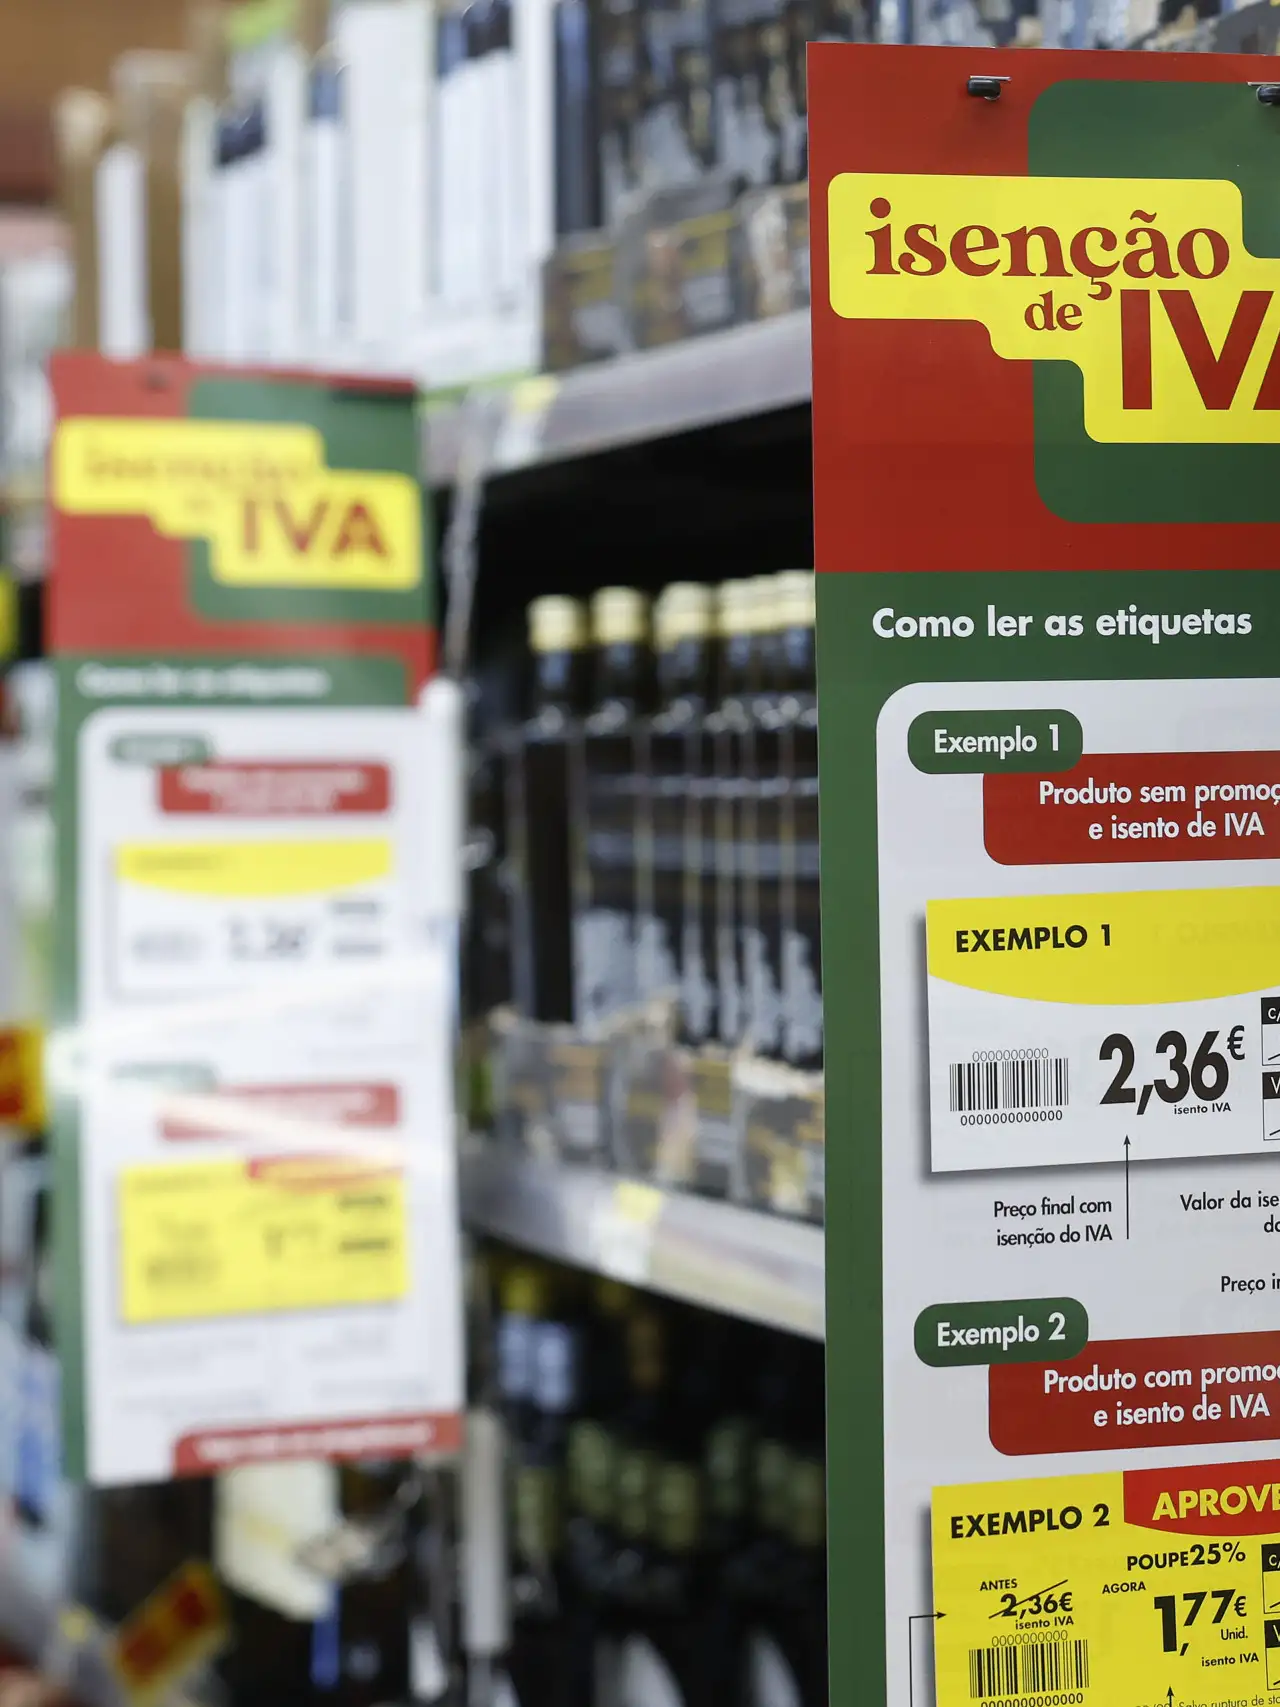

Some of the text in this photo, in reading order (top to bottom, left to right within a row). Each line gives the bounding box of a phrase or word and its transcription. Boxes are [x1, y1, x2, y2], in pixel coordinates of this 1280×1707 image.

[865, 197, 1230, 300] isenção
[1023, 289, 1083, 331] de
[872, 604, 1253, 644] Como ler as etiquetas
[934, 724, 1059, 759] Exemplo 1
[1039, 777, 1131, 804] Produto
[1140, 782, 1186, 802] sem
[1088, 811, 1265, 839] e isento de IVA
[955, 924, 1111, 953] EXEMPLO 1
[972, 1047, 1049, 1062] 0000000000
[1099, 1025, 1246, 1115] 2,36€
[960, 1109, 1063, 1126] 0000000000000
[1174, 1102, 1231, 1115] isento IVA
[993, 1197, 1112, 1220] Preço final com
[1180, 1193, 1225, 1211] Valor
[1229, 1190, 1252, 1209] da
[996, 1224, 1113, 1248] isenção do IVA
[1220, 1275, 1266, 1295] Preço
[937, 1312, 1066, 1351] Exemplo 2
[1044, 1364, 1137, 1394] Produto
[1144, 1367, 1192, 1389] com
[1093, 1393, 1270, 1427] e isento de IVA
[950, 1504, 1110, 1539] EXEMPLO 2
[979, 1578, 1018, 1591] ANTES
[1102, 1581, 1147, 1594] AGORA
[1000, 1591, 1073, 1620] 2,36€
[1015, 1615, 1074, 1630] isento IVA
[1154, 1589, 1247, 1656] 1,77€
[1221, 1626, 1248, 1641] Unid.
[1201, 1653, 1260, 1667] isento IVA
[1251, 1694, 1264, 1706] de
